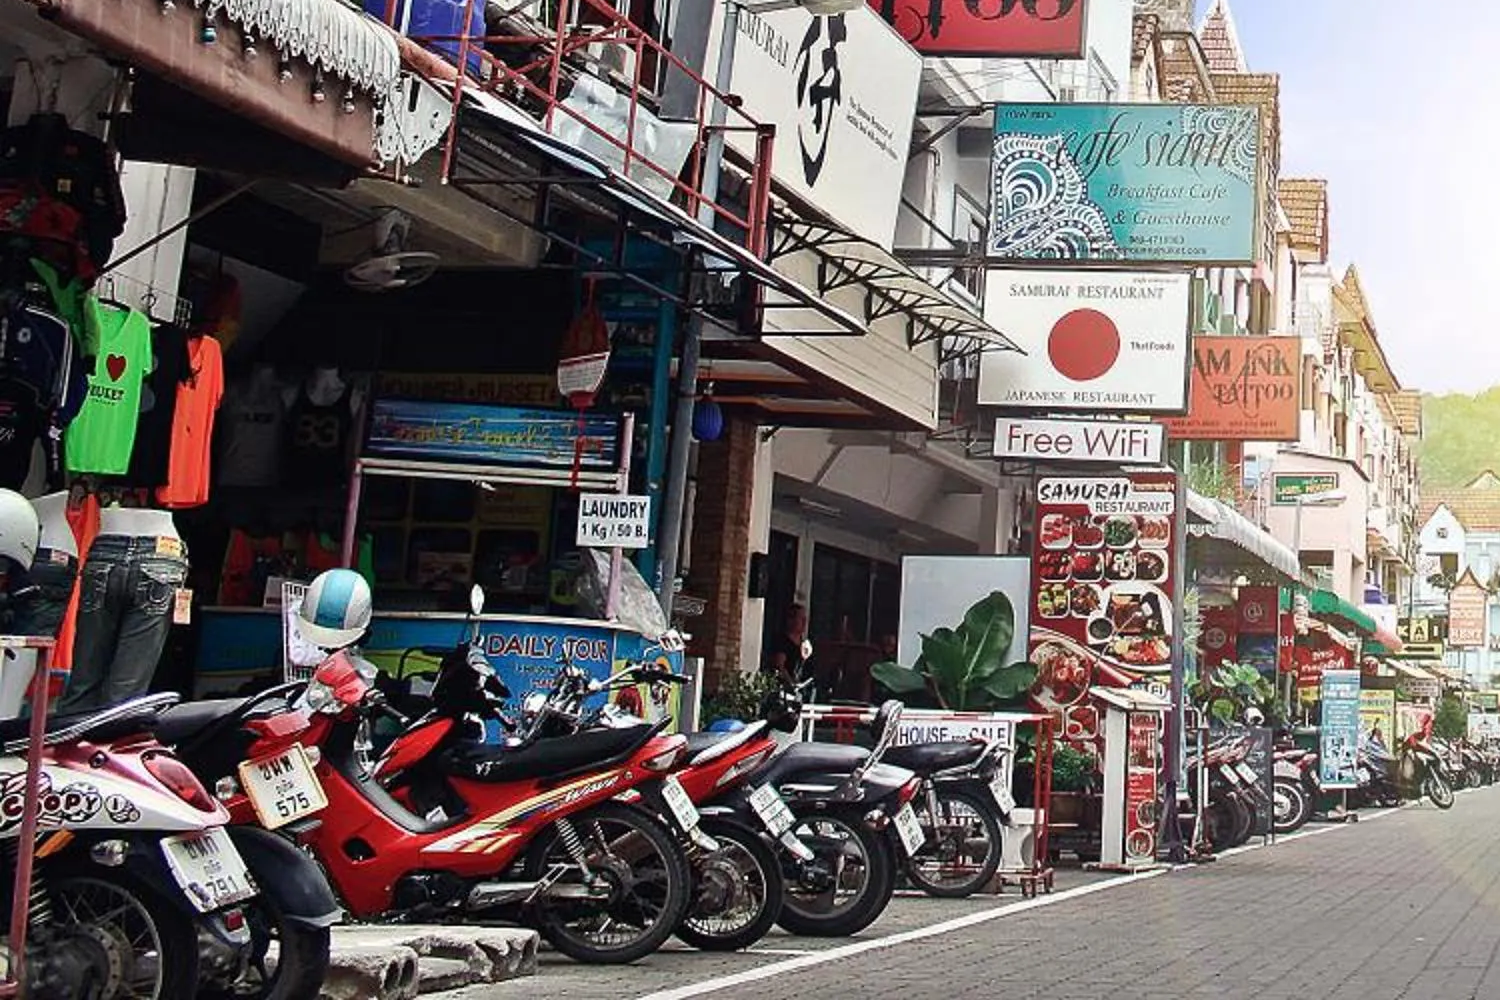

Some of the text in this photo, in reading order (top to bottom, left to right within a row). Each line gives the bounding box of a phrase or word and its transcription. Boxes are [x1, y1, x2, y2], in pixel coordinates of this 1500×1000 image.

[1107, 183, 1228, 199] Breakfast Cafe
[1111, 209, 1231, 226] & Guesthouse
[1009, 284, 1165, 300] SAMURAI RESTAURANT
[1005, 389, 1157, 404] JAPANESE RESTAURANT
[1007, 424, 1149, 457] Free WiFi
[1039, 483, 1129, 501] SAMURAI
[581, 499, 647, 518] LAUNDRY
[1095, 501, 1171, 513] RESTAURANT
[581, 523, 587, 536] 1
[592, 523, 607, 541] Kg
[487, 633, 609, 662] DAILY TOUR
[899, 726, 948, 745] HOUSE
[275, 792, 311, 818] 575
